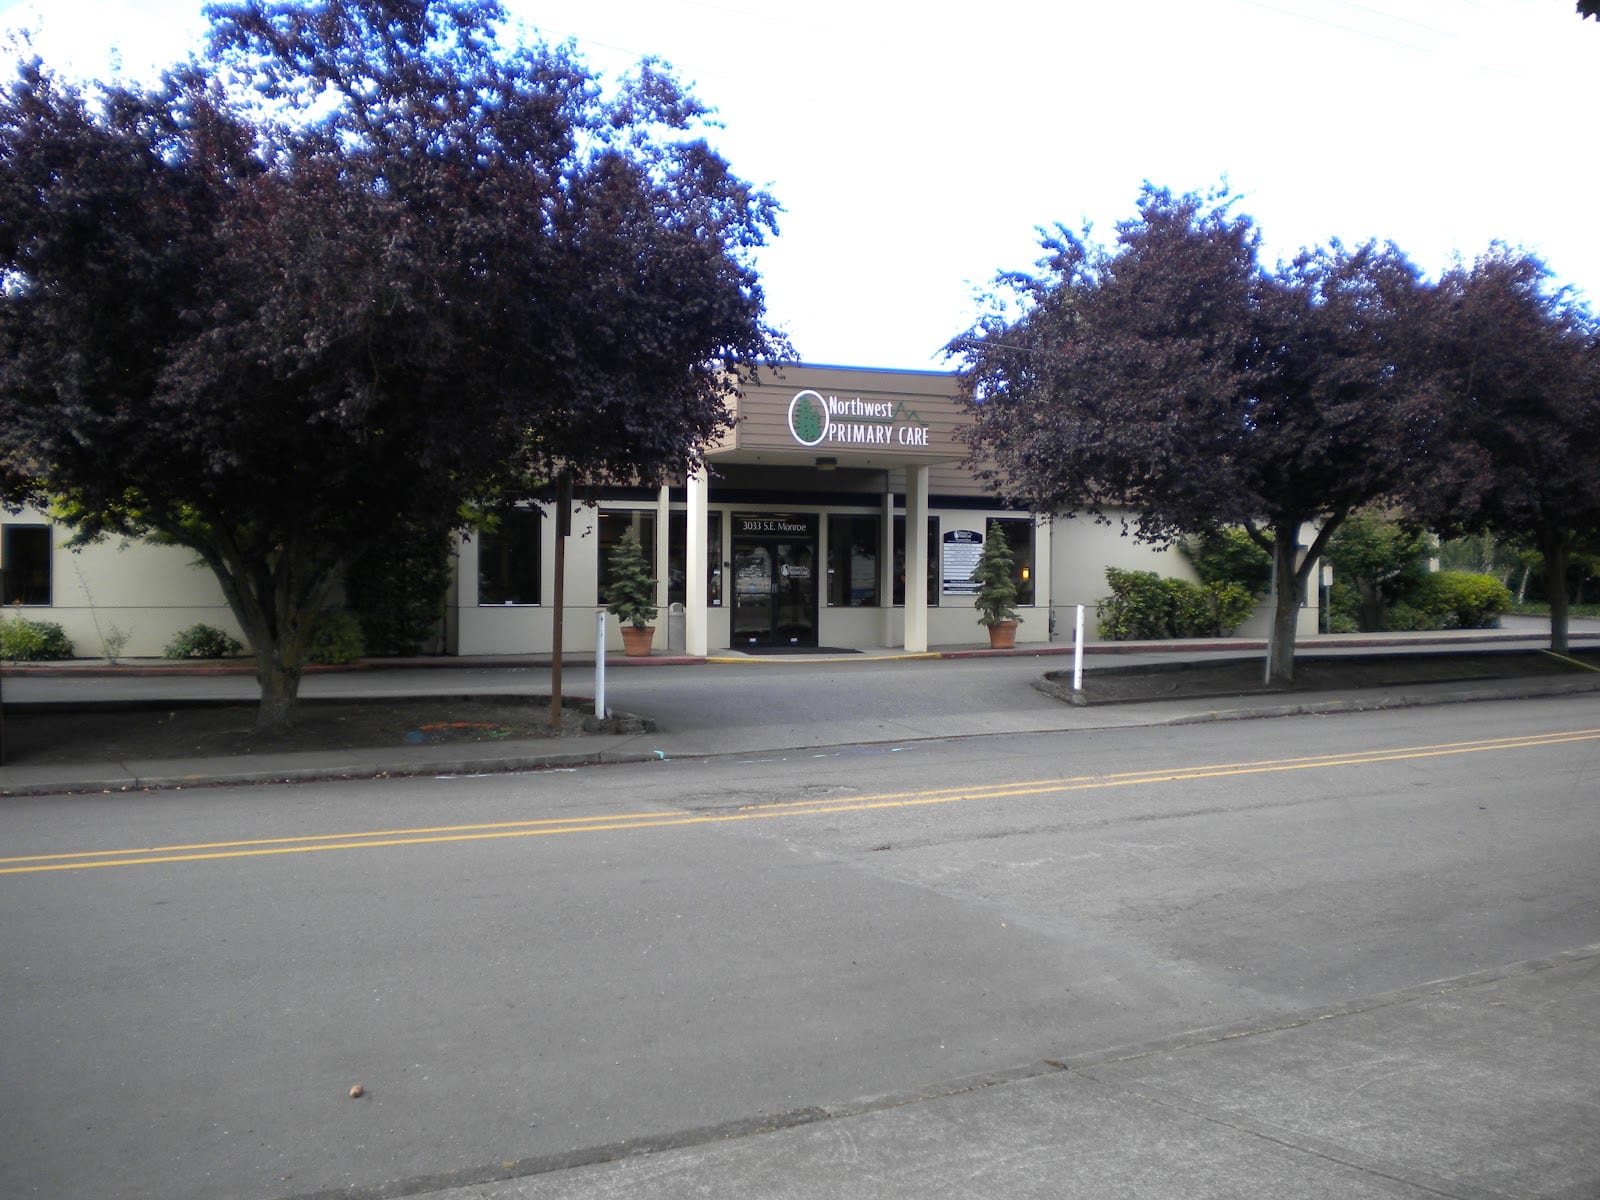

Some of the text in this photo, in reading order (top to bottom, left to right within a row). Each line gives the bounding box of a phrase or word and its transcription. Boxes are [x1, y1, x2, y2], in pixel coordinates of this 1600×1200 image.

[829, 396, 893, 418] Northwest
[829, 423, 929, 446] PRIMARY CARE
[743, 521, 807, 532] 3033 S.E. Monroe
